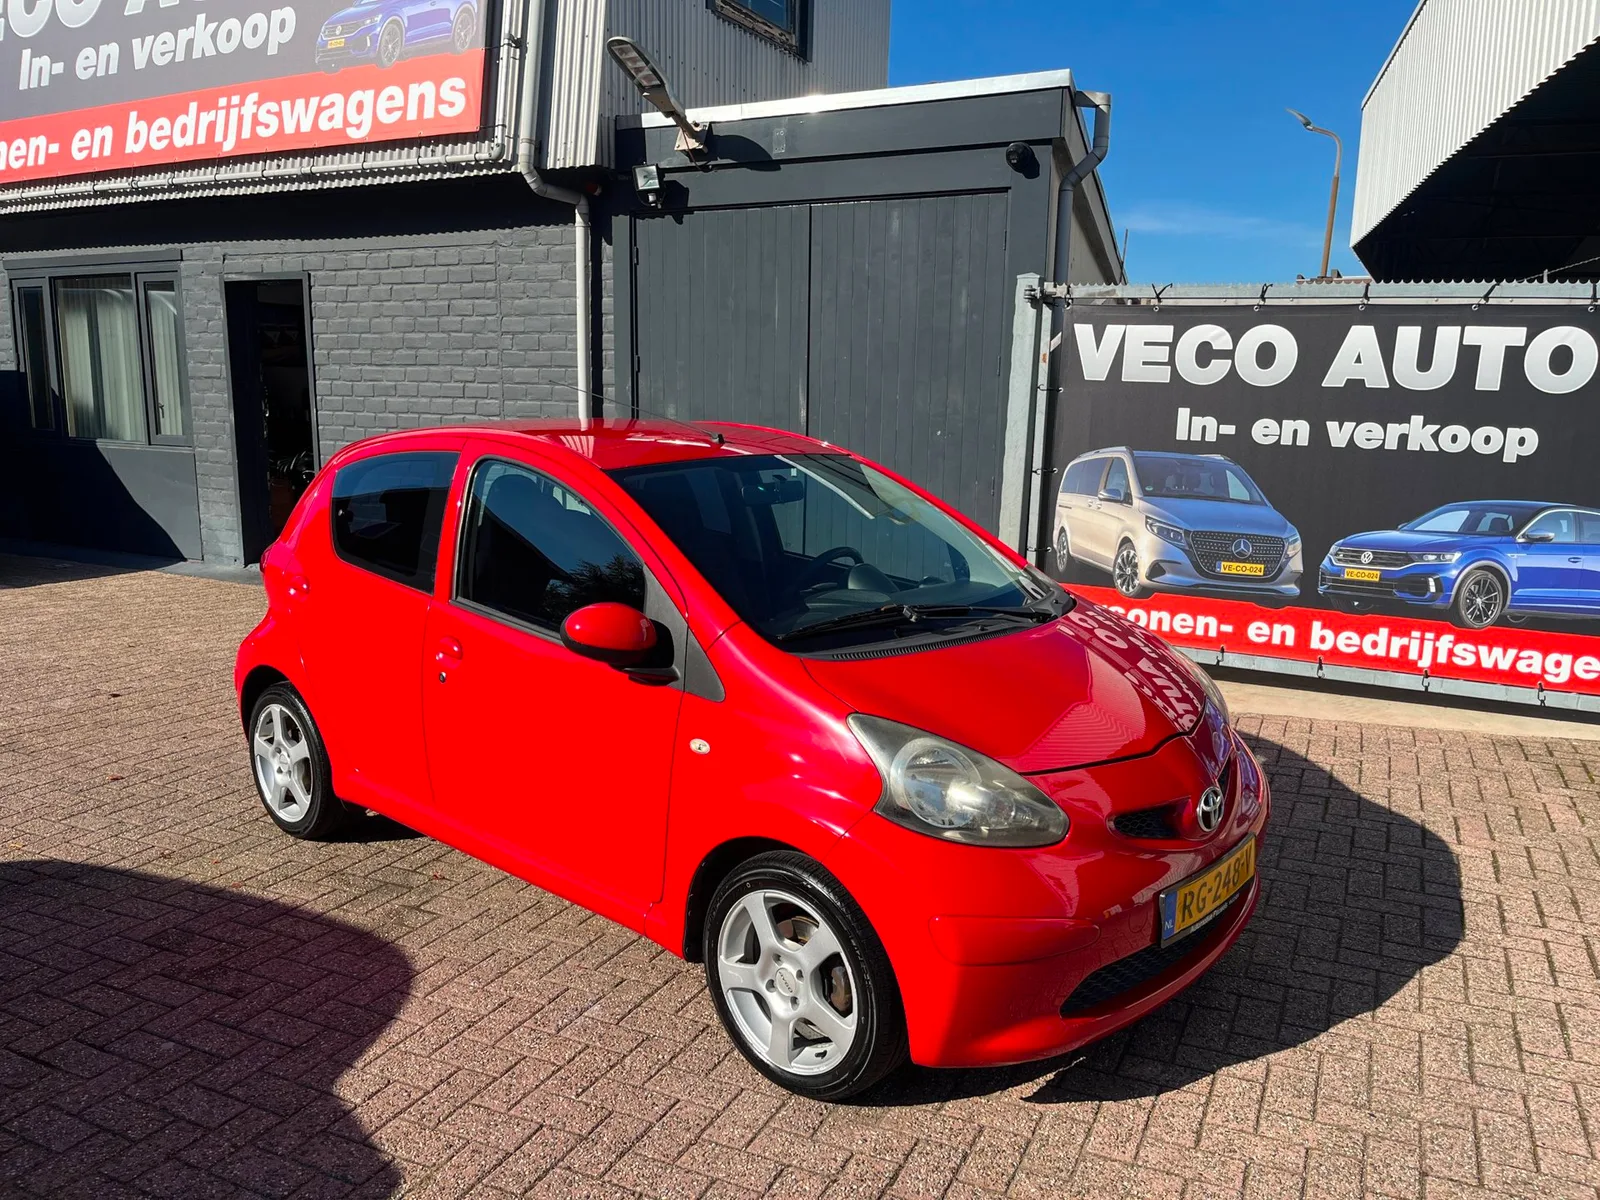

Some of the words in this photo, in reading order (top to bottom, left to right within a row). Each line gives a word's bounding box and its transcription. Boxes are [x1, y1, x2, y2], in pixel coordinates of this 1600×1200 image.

[19, 48, 64, 90] In-
[75, 41, 120, 80] en
[132, 6, 296, 70] verkoop
[71, 125, 113, 161] en
[125, 77, 467, 154] bedrijfswagens
[1074, 323, 1298, 386] VECO
[1321, 325, 1599, 394] AUTO
[1176, 407, 1236, 443] In-
[1251, 415, 1310, 446] en
[1326, 415, 1539, 463] verkoop
[1222, 564, 1262, 573] VE-CO-024
[1247, 620, 1295, 648] en
